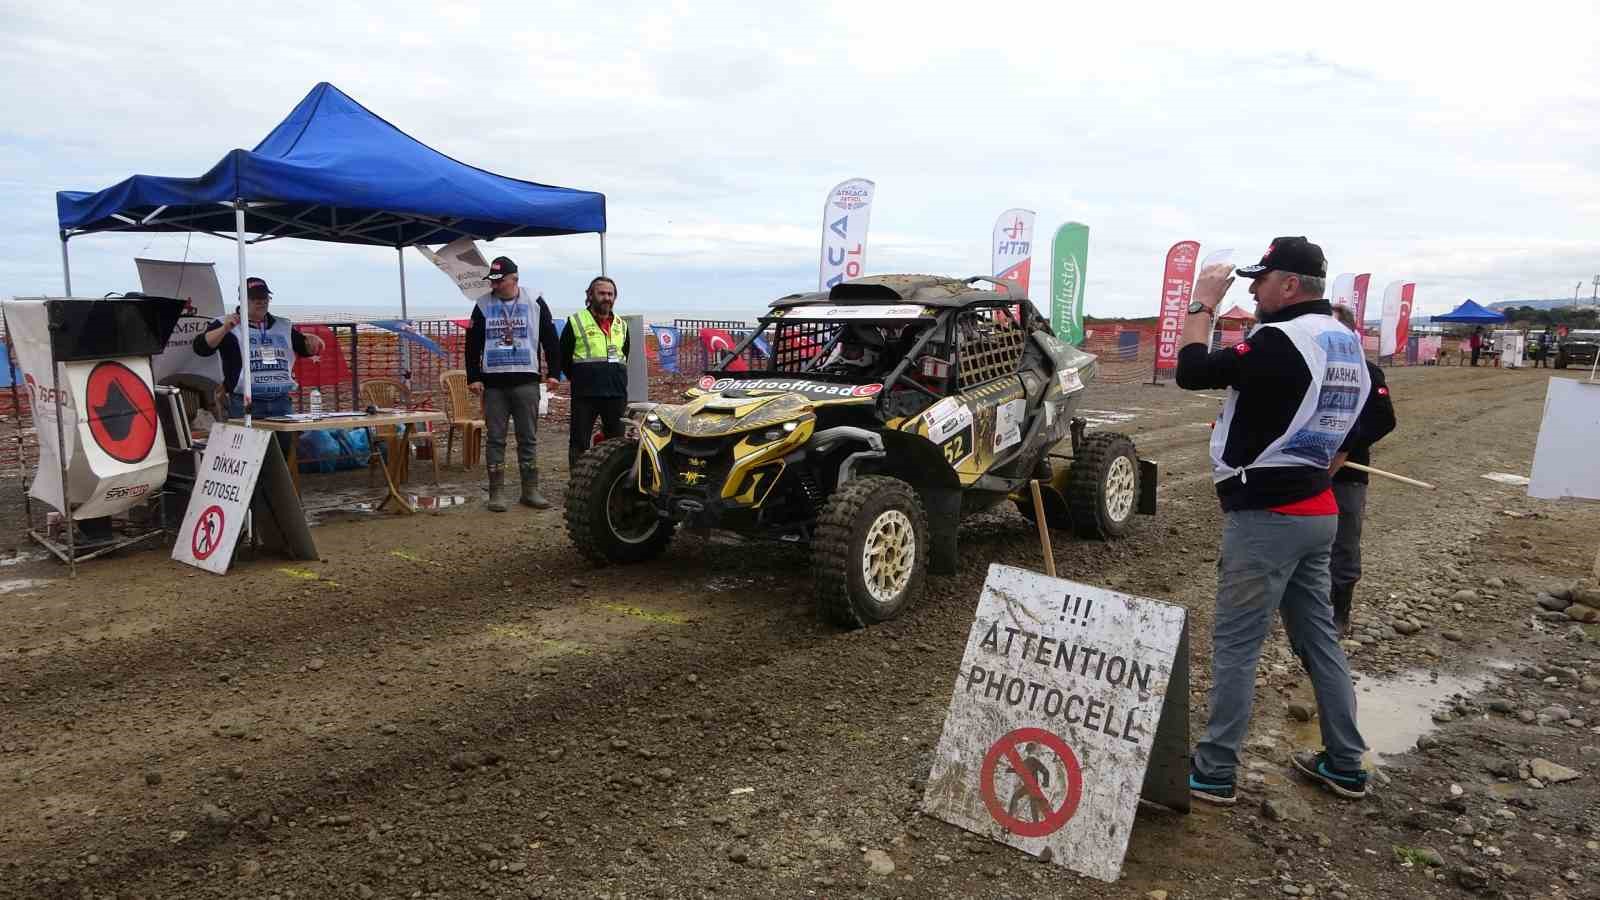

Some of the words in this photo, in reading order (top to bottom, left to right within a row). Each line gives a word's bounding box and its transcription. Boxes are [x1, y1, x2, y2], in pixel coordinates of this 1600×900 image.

[212, 452, 248, 476] DİKKAT
[943, 435, 965, 464] 52
[201, 479, 241, 502] FOTOSEL
[1059, 595, 1093, 627] !!!
[979, 623, 1150, 690] ATTENTION
[965, 665, 1141, 743] PHOTOCELL
